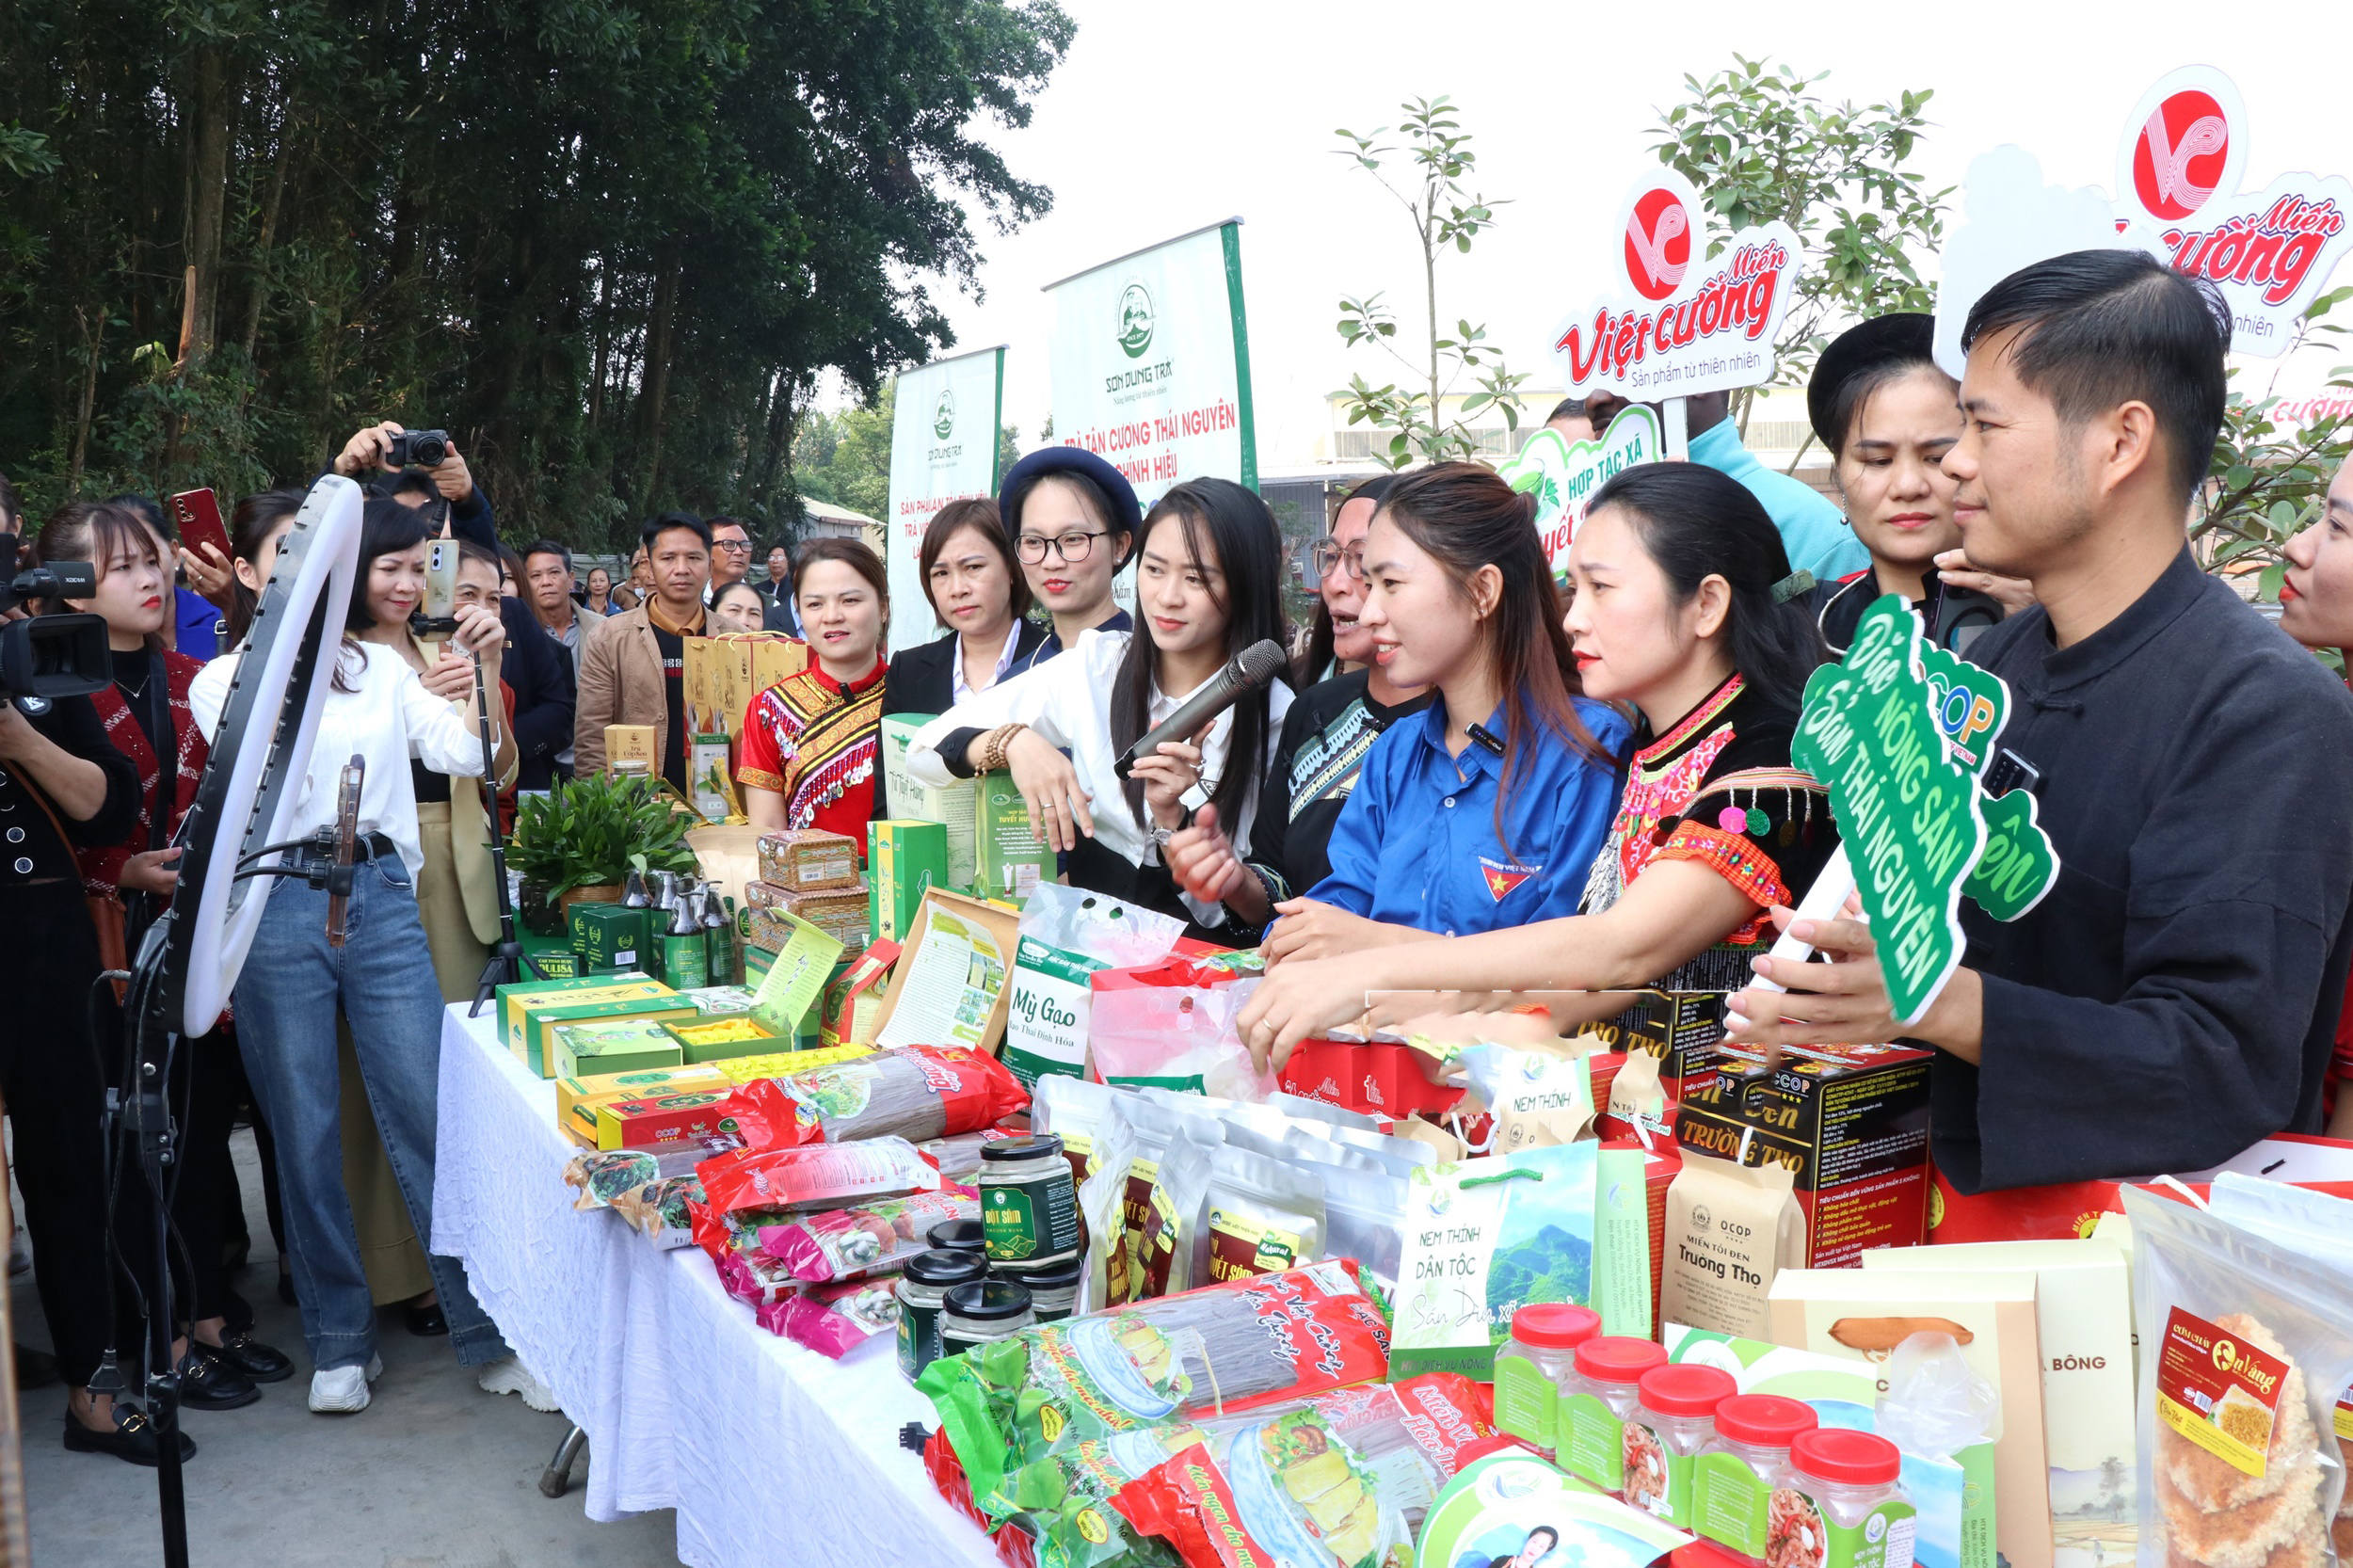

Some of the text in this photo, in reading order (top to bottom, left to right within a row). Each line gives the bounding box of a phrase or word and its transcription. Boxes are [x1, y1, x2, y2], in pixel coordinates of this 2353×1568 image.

[2247, 193, 2345, 237] Miến
[1719, 240, 1788, 283] Miến
[2233, 314, 2274, 338] nhiên
[1556, 307, 1653, 385] Việt
[1106, 357, 1173, 393] SƠN DUNG TRÀ
[1631, 352, 1761, 388] Sản phẩm từ thiên nhiên
[1085, 398, 1236, 455] TÂN CƯƠNG THÁI NGUYÊN
[1154, 448, 1177, 486] HIỆU
[1568, 432, 1642, 501] HỢP TÁC XÃ
[901, 497, 915, 516] SẢN
[904, 520, 918, 537] TRÀ
[1848, 613, 1906, 694] Đặc
[1804, 678, 1865, 766] Sản
[1955, 744, 1977, 764] VIETNAM
[1874, 686, 1964, 888] NÔNG SẢN
[999, 815, 1016, 824] TUYẾT
[1841, 740, 1887, 840] THÁI
[1864, 814, 1941, 998] NGUYÊN
[1013, 987, 1076, 1029] Mỳ Gạo
[1021, 1024, 1036, 1037] Thai
[1037, 1031, 1053, 1043] Định
[1055, 1036, 1074, 1048] Hóa
[1514, 1088, 1571, 1112] NEM THÍNH
[1684, 1120, 1758, 1162] TRƯỜNG
[1832, 1192, 1849, 1202] CHUẨN
[1849, 1189, 1860, 1197] BỀN
[1861, 1186, 1874, 1194] VỮNG
[1875, 1182, 1884, 1191] SẢN
[984, 1208, 1000, 1225] BỘT
[1721, 1221, 1751, 1237] OCOP
[1823, 1212, 1839, 1221] Không
[1823, 1221, 1838, 1229] Không
[1419, 1224, 1481, 1247] NEM THÍNH
[1822, 1229, 1838, 1238] Không
[1822, 1238, 1837, 1246] Không
[1259, 1242, 1289, 1256] Natural
[1687, 1235, 1750, 1262] MIẾN TỎI ĐEN
[1837, 1254, 1849, 1264] MIẾN
[1416, 1253, 1476, 1280] DÂN TỘC
[1679, 1243, 1761, 1289] Trường Thọ
[2173, 1323, 2191, 1340] CƠM
[2053, 1353, 2106, 1371] BÔNG
[1413, 1384, 1463, 1431] Miến
[1400, 1415, 1442, 1454] Hóa
[1184, 1464, 1245, 1547] Món ngon cho
[1854, 1544, 1881, 1560] NEM THÍNH
